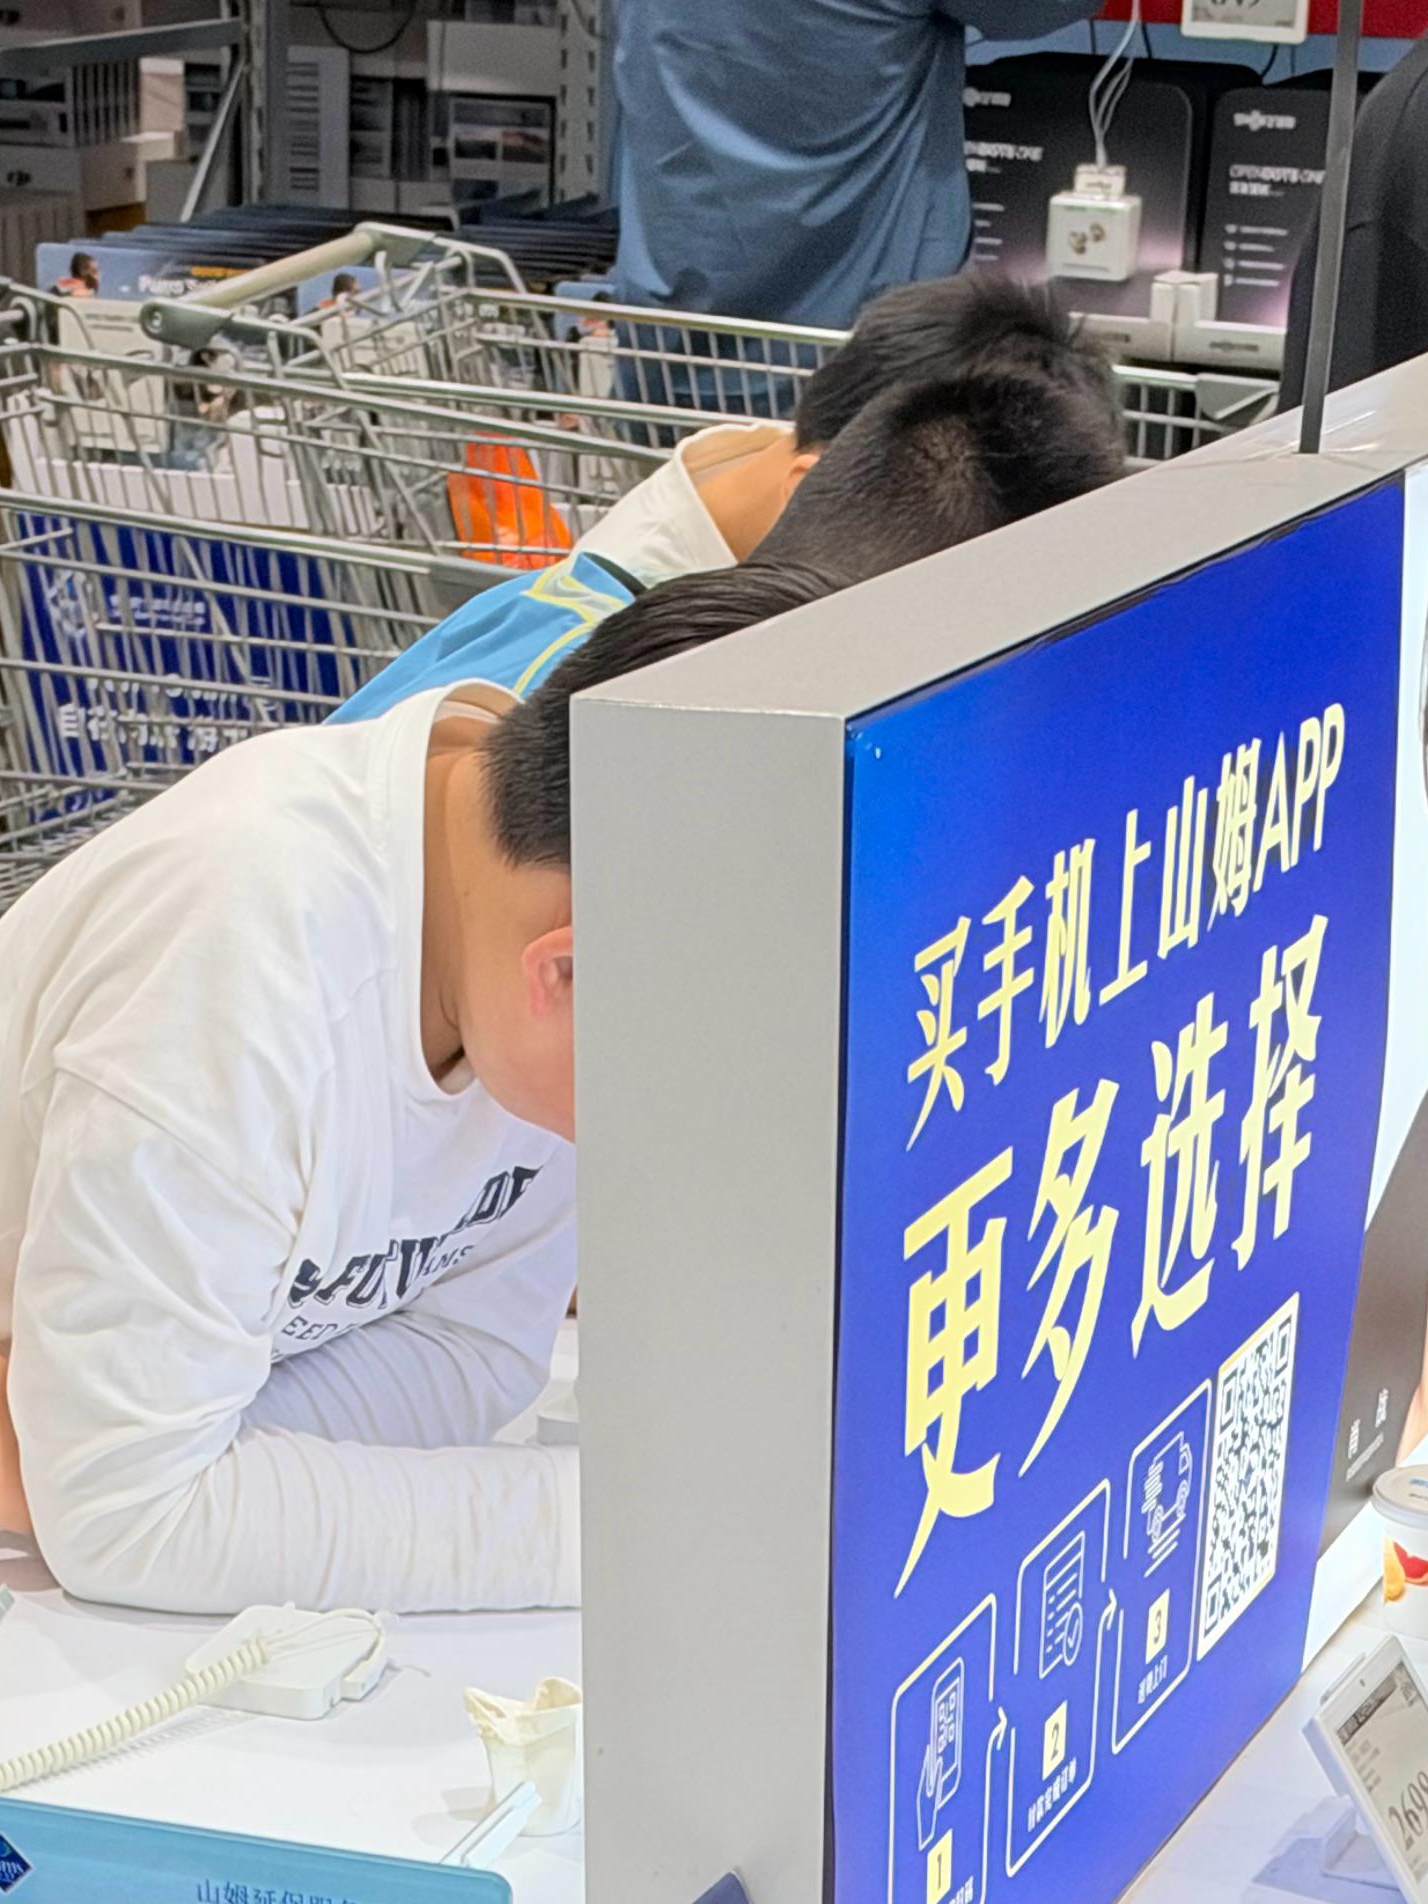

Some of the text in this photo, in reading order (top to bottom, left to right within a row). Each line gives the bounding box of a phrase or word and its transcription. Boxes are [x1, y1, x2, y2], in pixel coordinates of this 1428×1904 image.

[907, 702, 1346, 1152] 买手机上山姆APP
[893, 914, 1329, 1599] 更多选择
[1049, 1725, 1062, 1762] 2
[1153, 1608, 1164, 1645] 3
